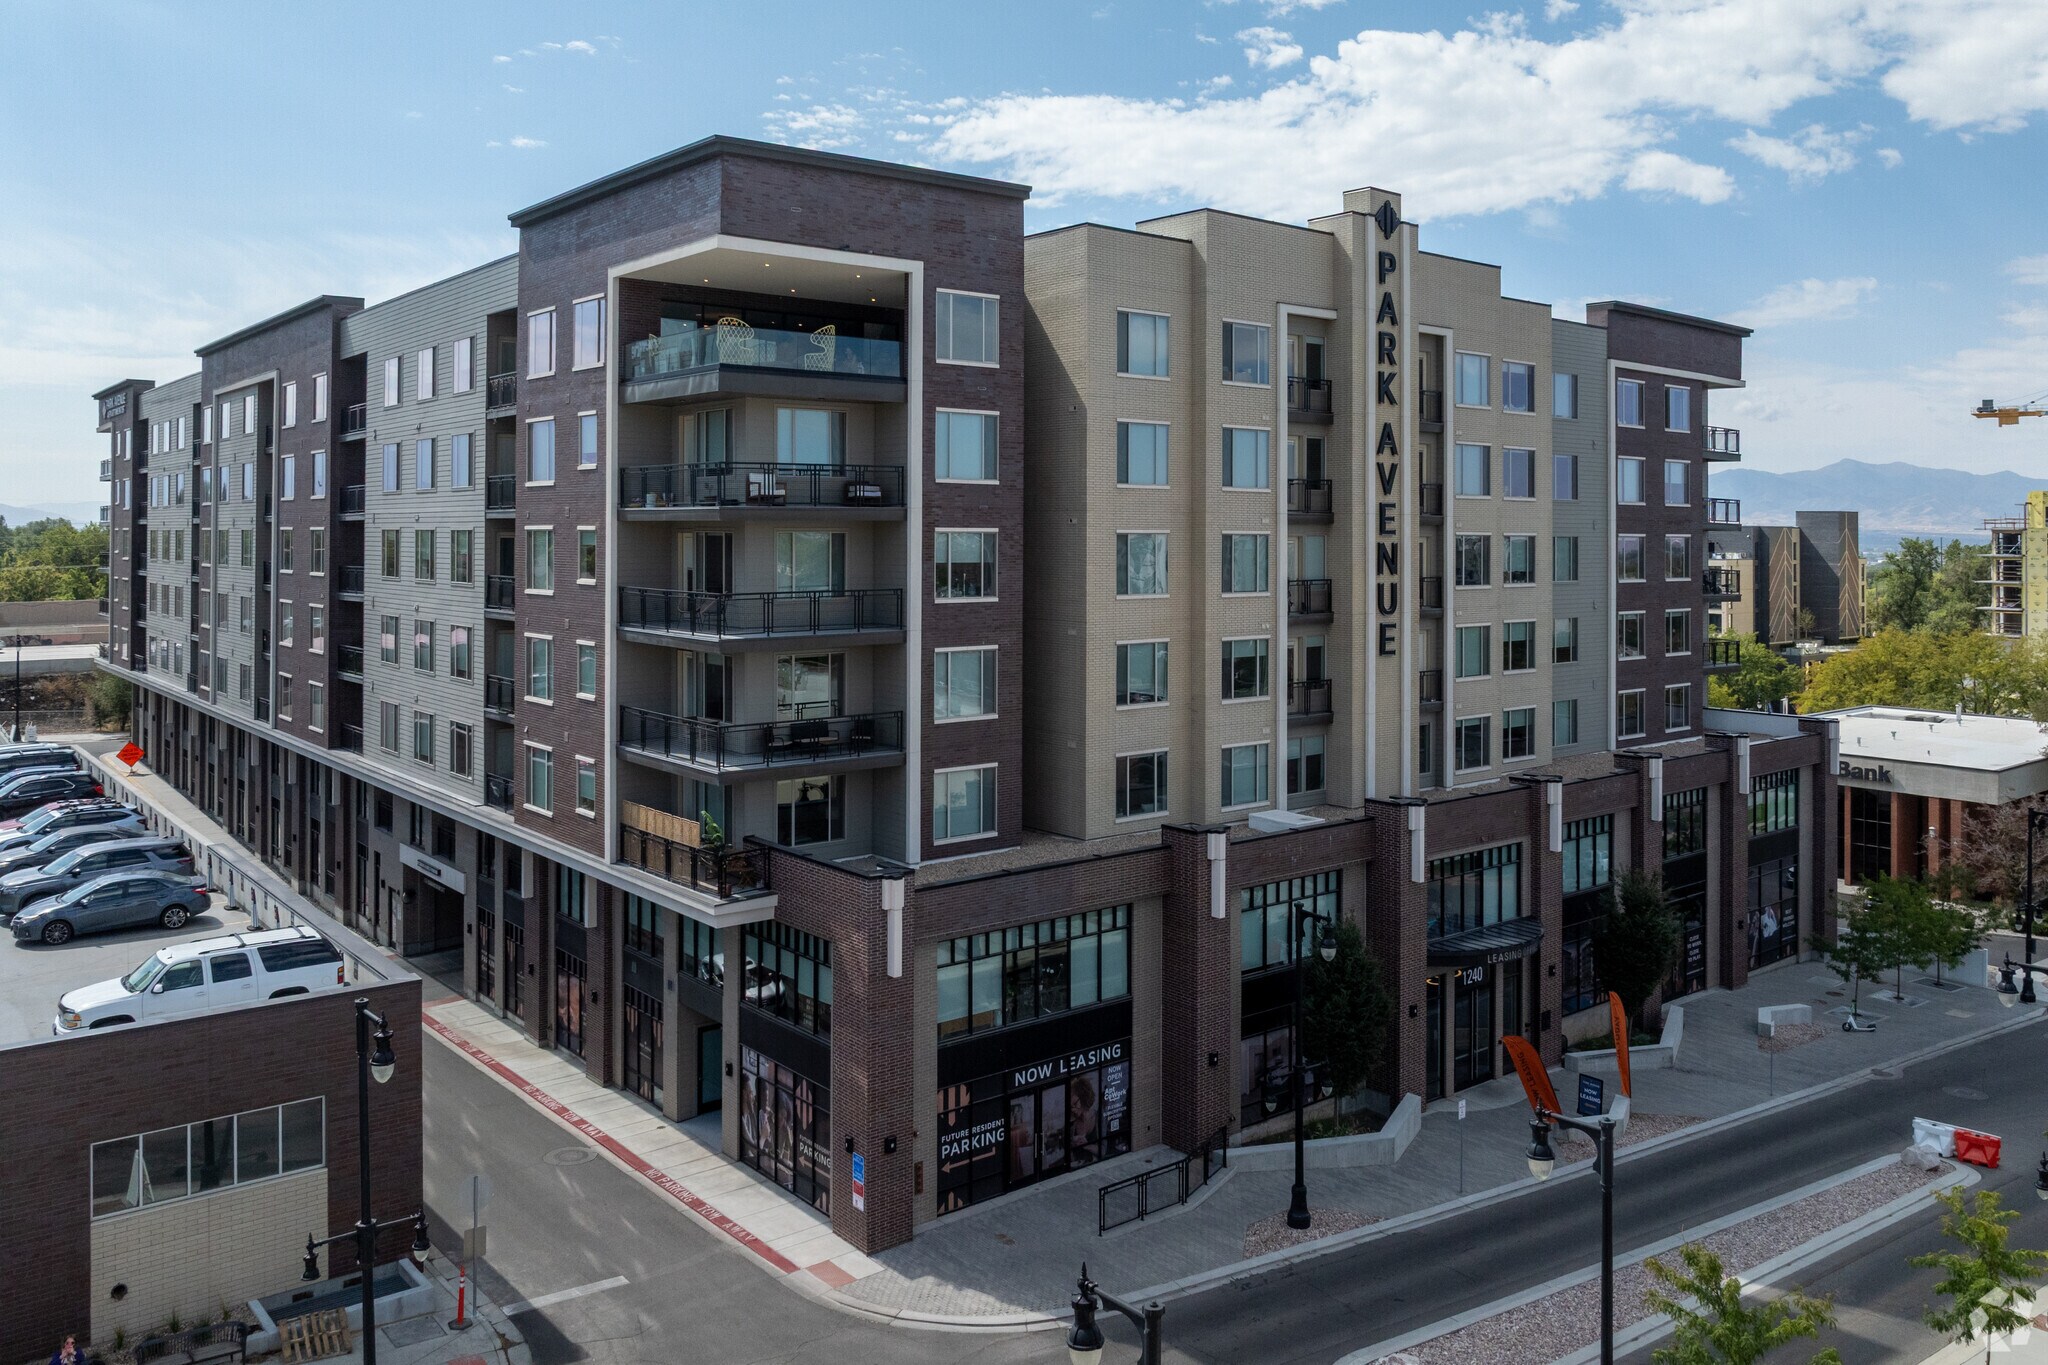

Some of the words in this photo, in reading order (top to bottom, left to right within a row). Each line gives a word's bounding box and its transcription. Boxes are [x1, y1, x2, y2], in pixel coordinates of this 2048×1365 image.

[1376, 251, 1398, 406] PARK
[1376, 422, 1399, 656] AVENUE
[1839, 760, 1892, 784] Bank
[1487, 949, 1522, 964] LEASING
[1463, 966, 1483, 985] 1240
[1015, 1062, 1053, 1087] NOW
[1060, 1044, 1121, 1073] LEASING
[1107, 1072, 1123, 1082] OPEN
[1108, 1065, 1121, 1074] NOW
[1517, 1052, 1537, 1088] LEASING
[1580, 1092, 1601, 1104] LEASING
[532, 1091, 563, 1111] PARKING
[578, 1123, 607, 1138] AWAY
[941, 1128, 970, 1143] FUTURE
[972, 1118, 1005, 1134] RESIDENT
[941, 1128, 1005, 1159] PARKING
[800, 1142, 831, 1168] PARKING
[644, 1168, 660, 1179] NO
[656, 1177, 696, 1203] PARKING
[698, 1204, 722, 1220] TOW
[722, 1222, 758, 1241] AWAY
